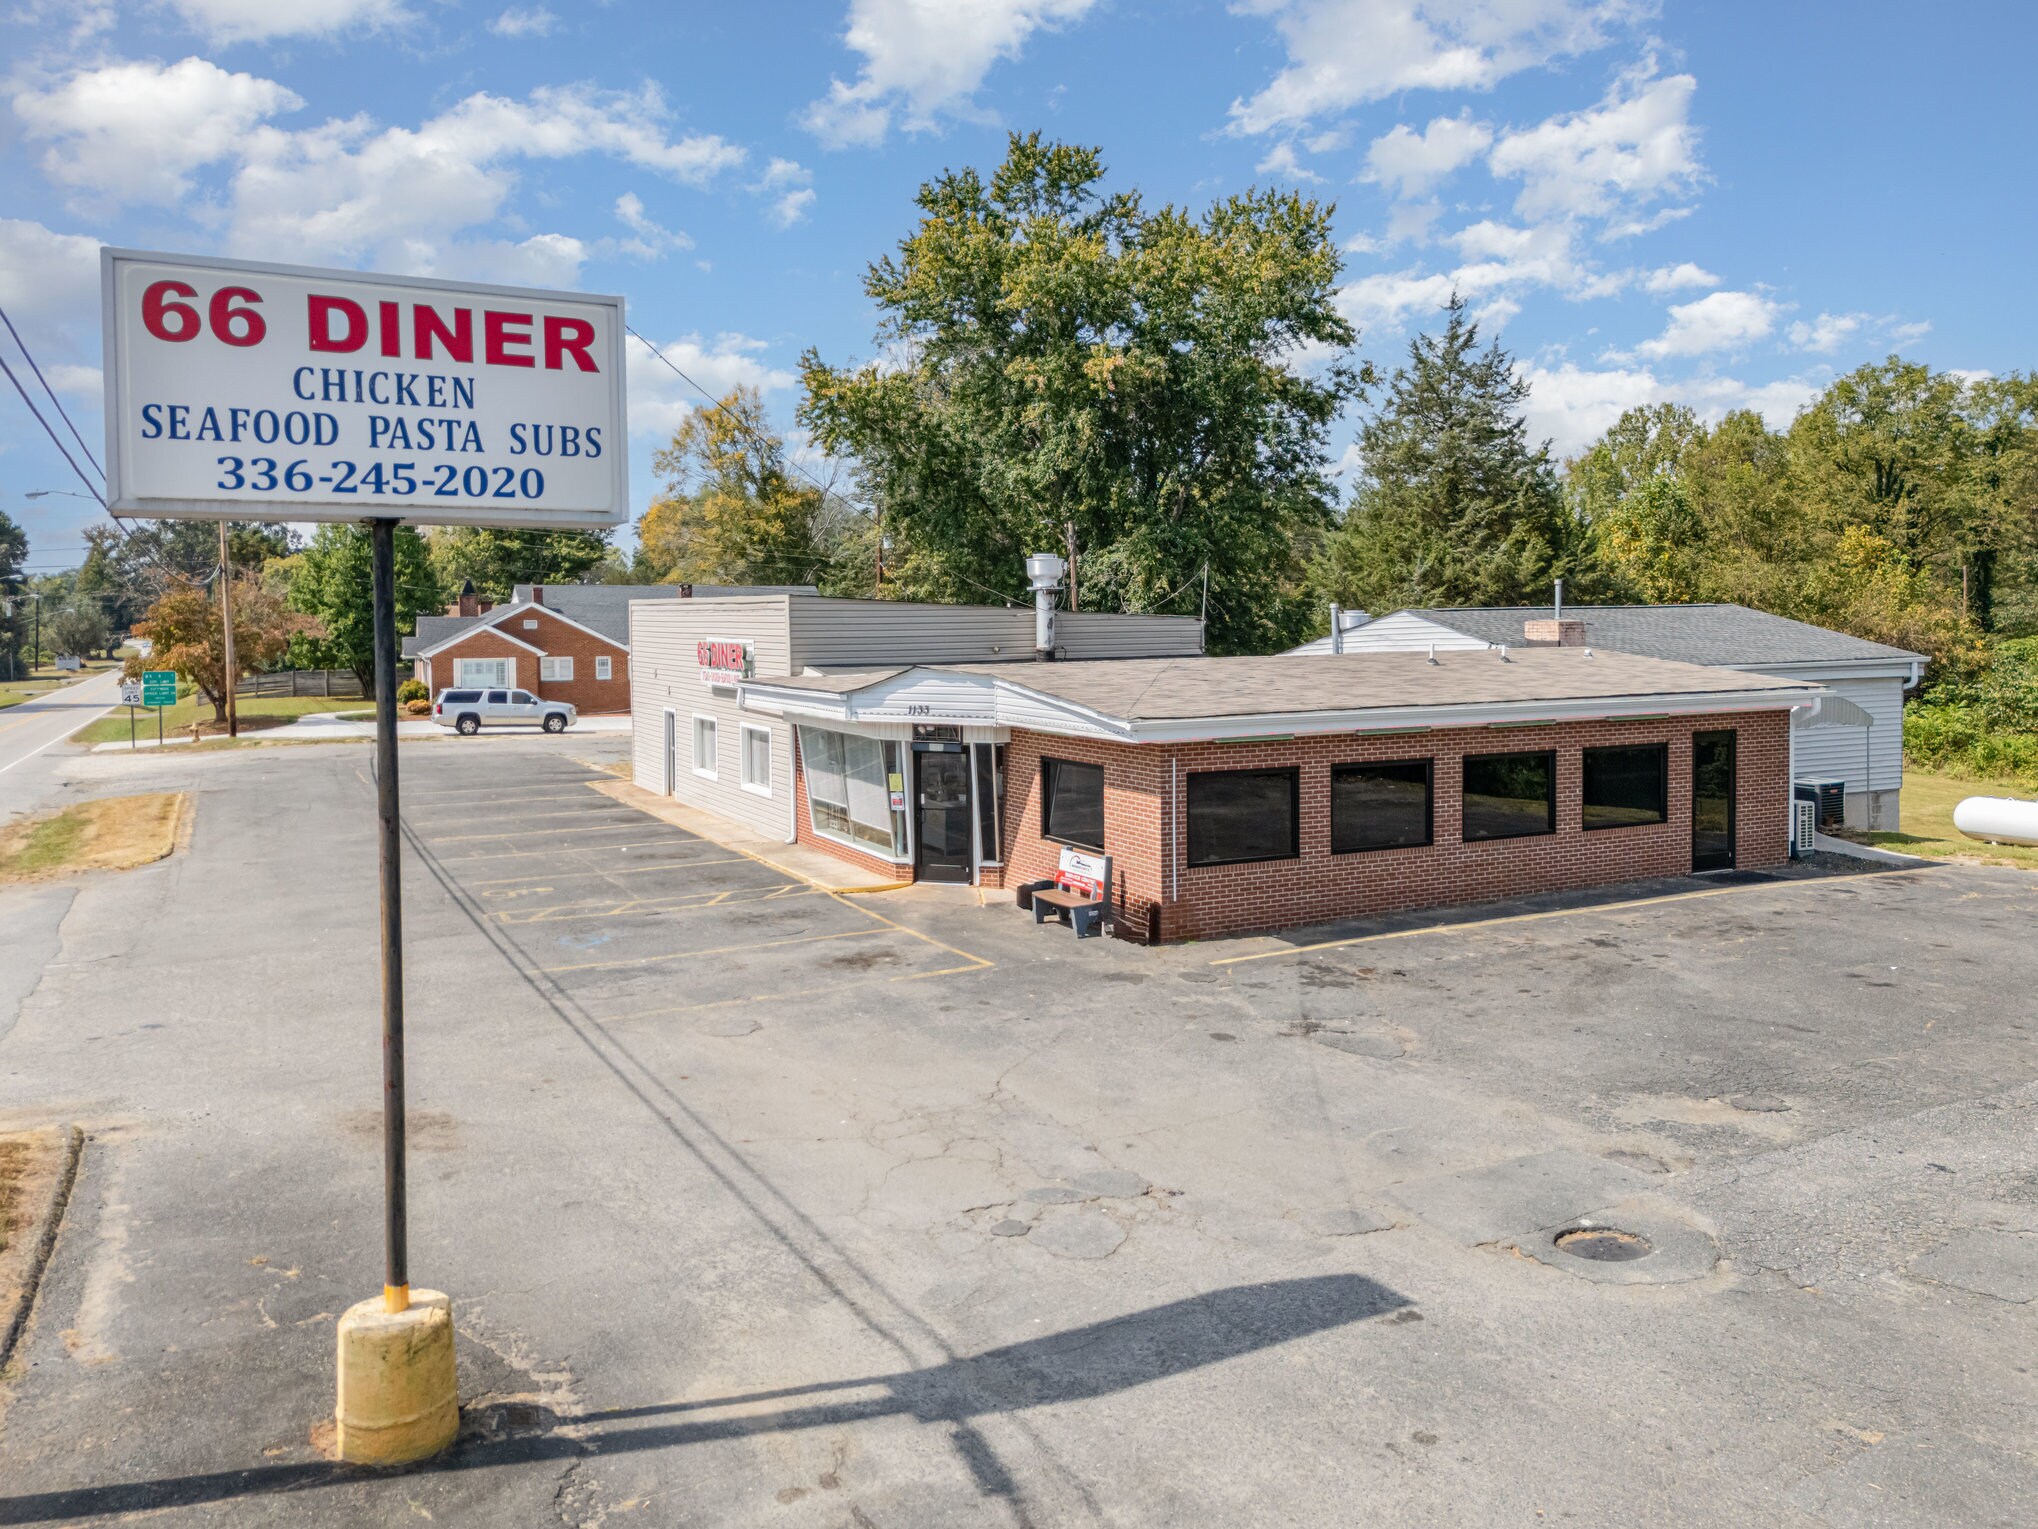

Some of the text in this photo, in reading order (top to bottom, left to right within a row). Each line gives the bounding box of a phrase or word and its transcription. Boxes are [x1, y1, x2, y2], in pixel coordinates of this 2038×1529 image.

[141, 280, 600, 373] 66 DINER
[293, 366, 475, 409] CHICKEN
[141, 403, 602, 458] SEAFOOD PASTA SUBS
[216, 456, 545, 499] 336-245-2020
[710, 643, 745, 671] DINER
[124, 695, 140, 703] 45
[908, 704, 930, 715] 1133
